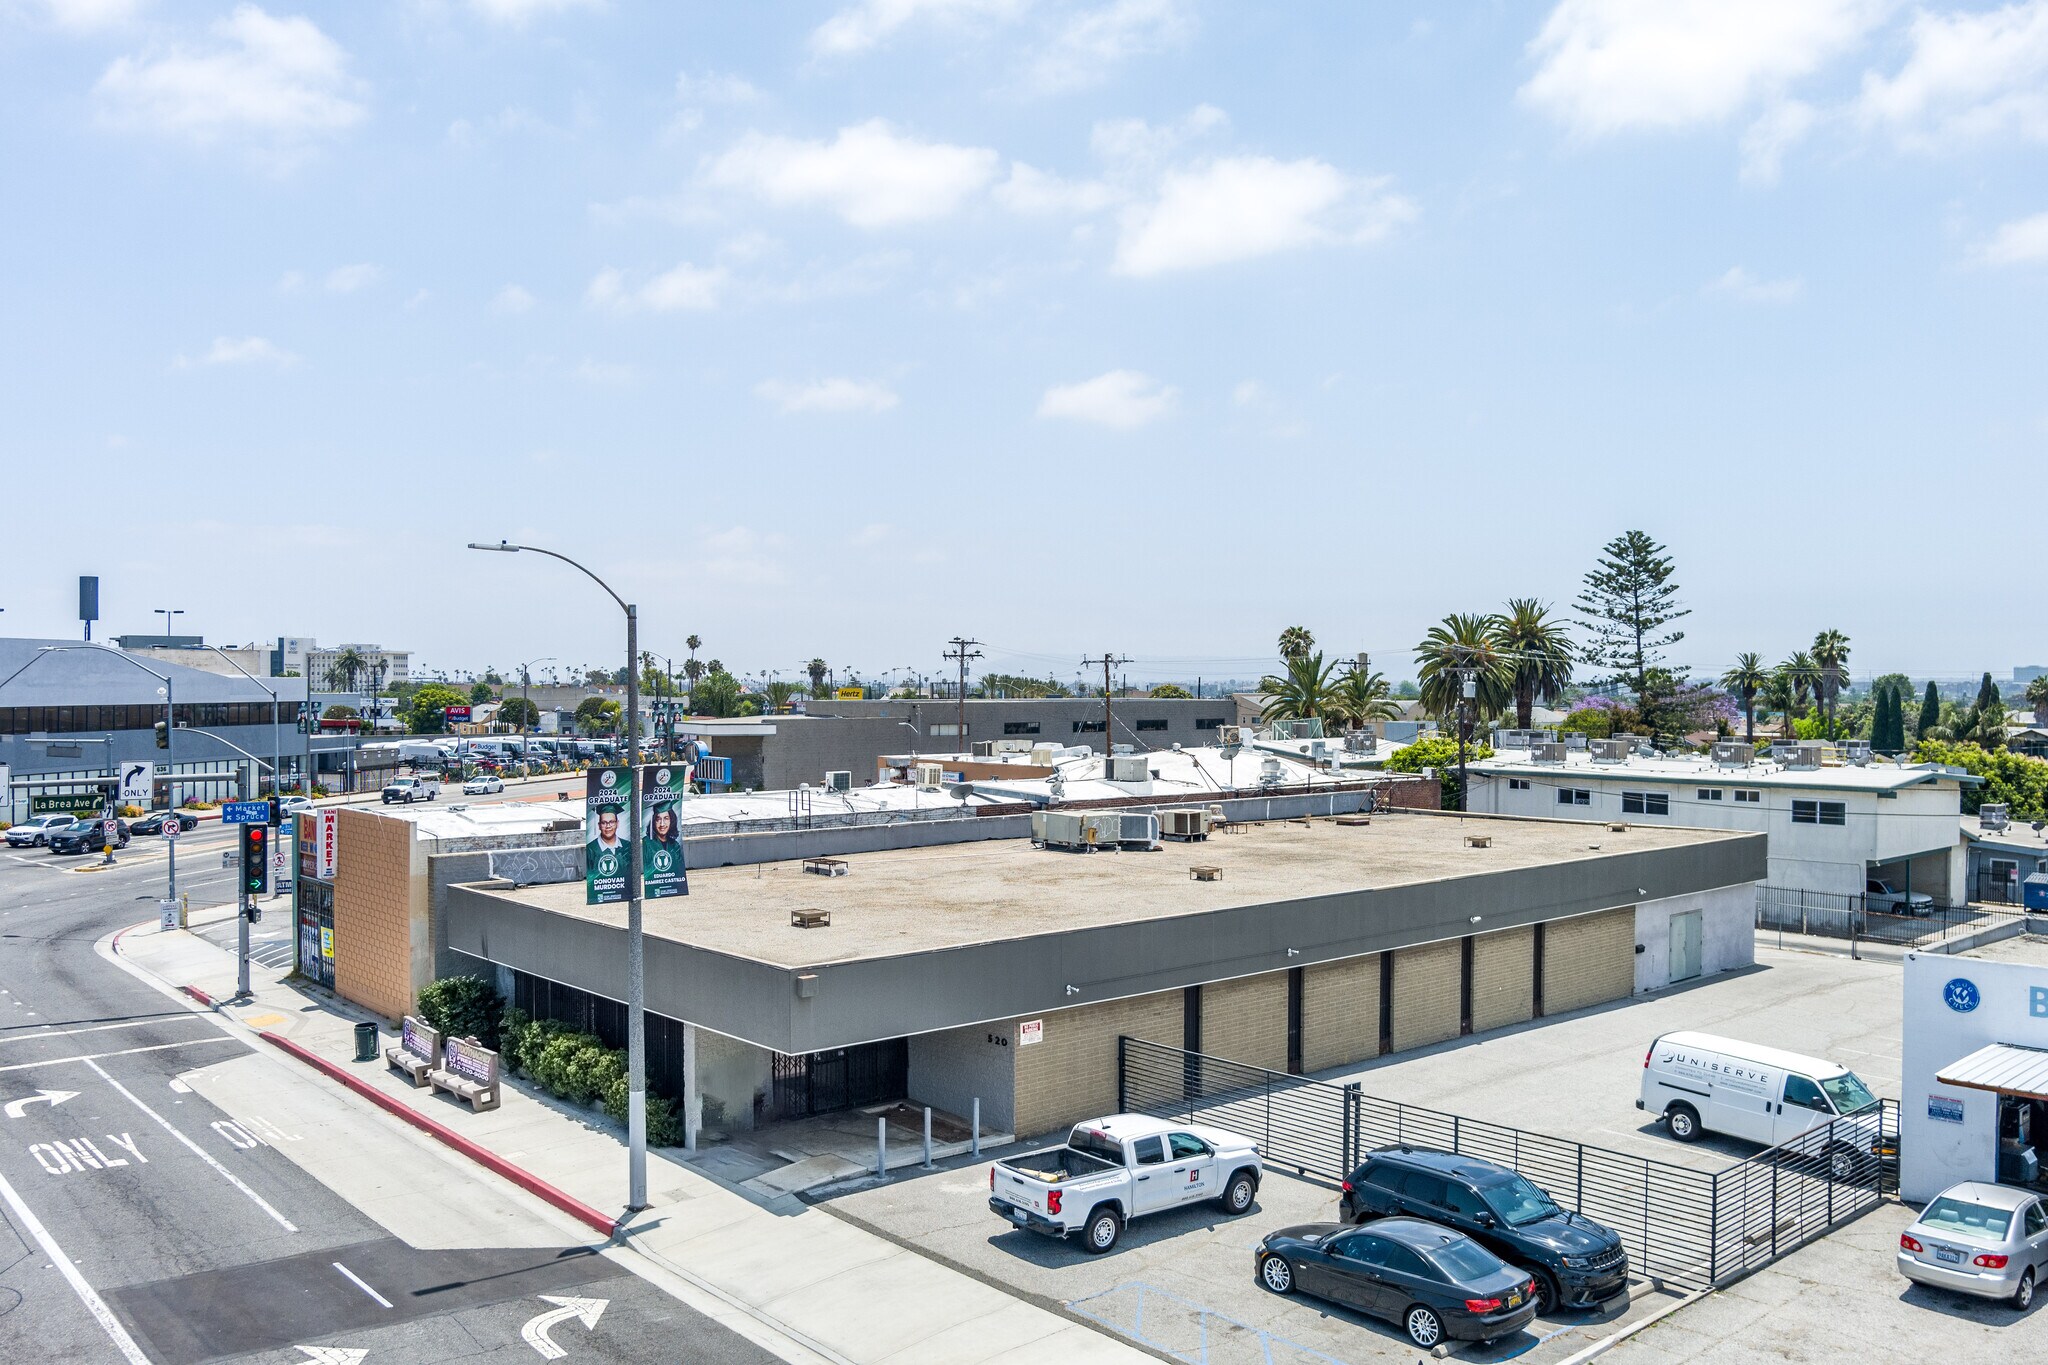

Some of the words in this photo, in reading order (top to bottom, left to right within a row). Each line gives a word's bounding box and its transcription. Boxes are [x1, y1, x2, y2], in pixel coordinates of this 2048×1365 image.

[35, 801, 46, 809] La
[48, 800, 71, 808] Brea
[74, 799, 90, 808] Ave
[325, 816, 334, 867] MARKET
[594, 877, 624, 885] DONOVAN
[1948, 997, 1974, 1009] CHECK
[988, 1034, 1008, 1046] 520
[1676, 1054, 1768, 1082] UNISERVE
[28, 1132, 148, 1174] ONLY
[1191, 1170, 1198, 1182] H
[1184, 1182, 1205, 1191] HAMILTON
